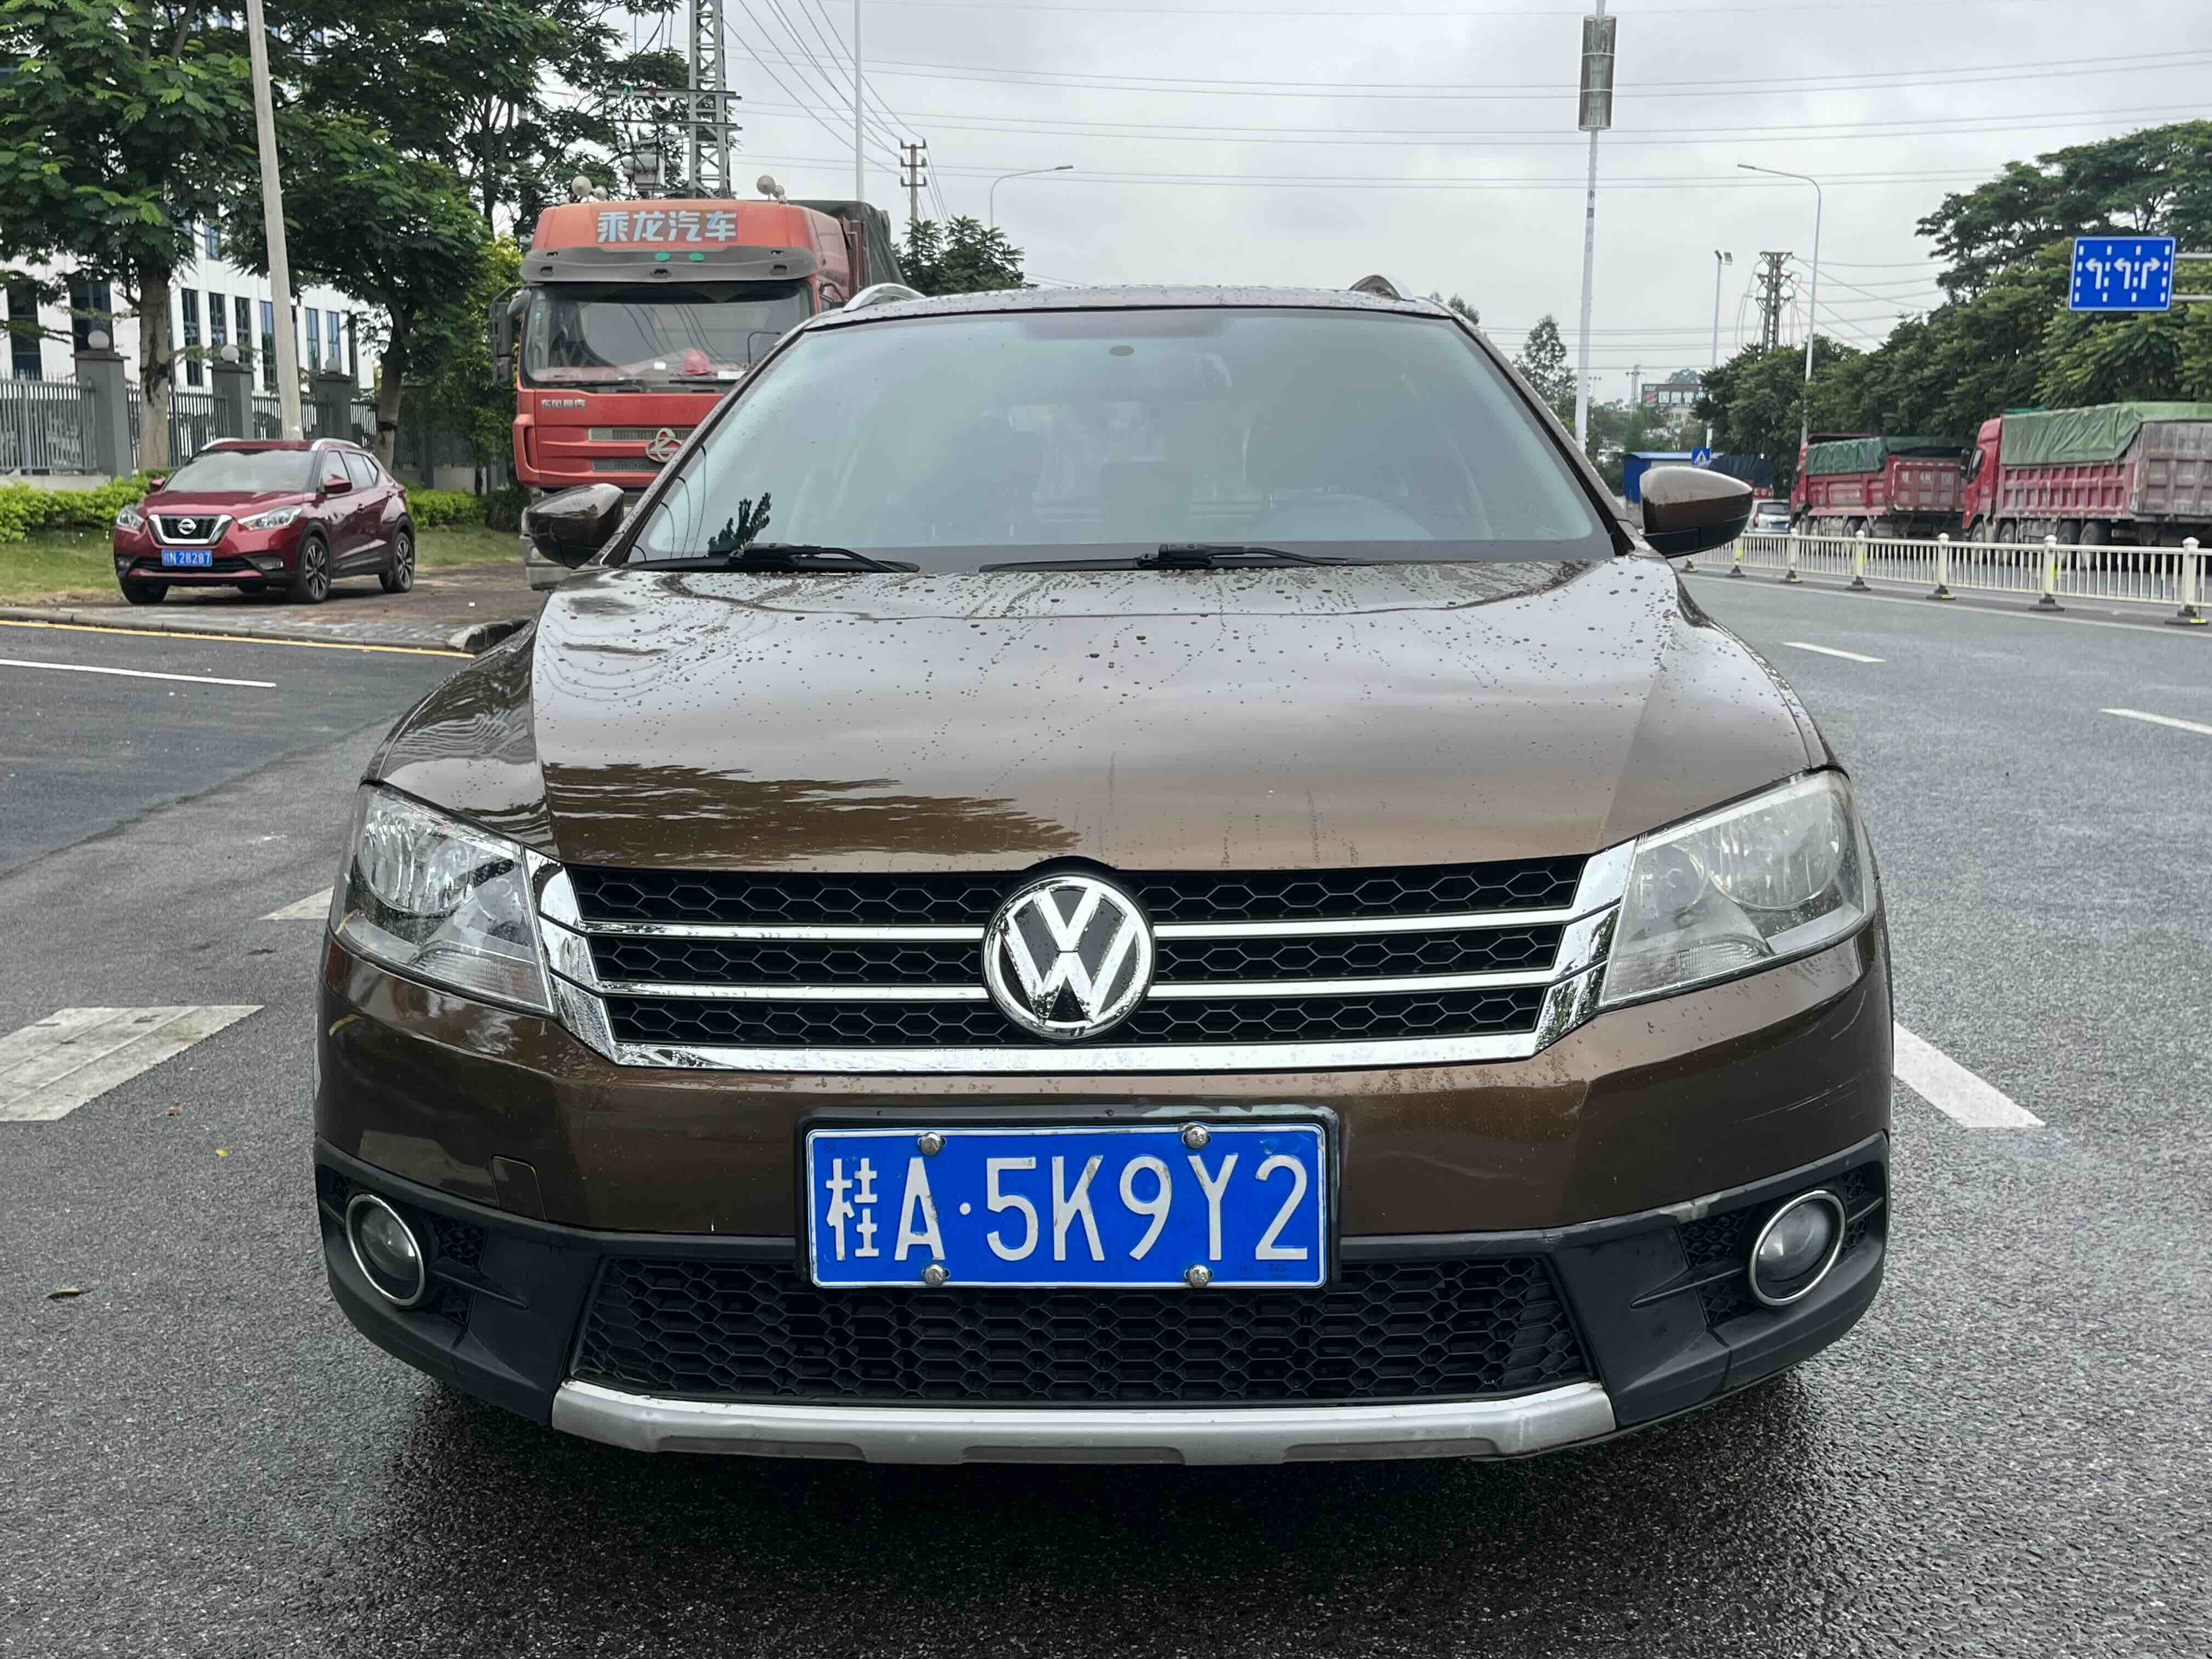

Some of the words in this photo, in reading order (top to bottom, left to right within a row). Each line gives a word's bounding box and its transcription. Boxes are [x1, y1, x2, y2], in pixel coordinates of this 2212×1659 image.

[597, 211, 737, 242] 乘龙汽车
[826, 1154, 1308, 1262] 桂A·5K9Y2
